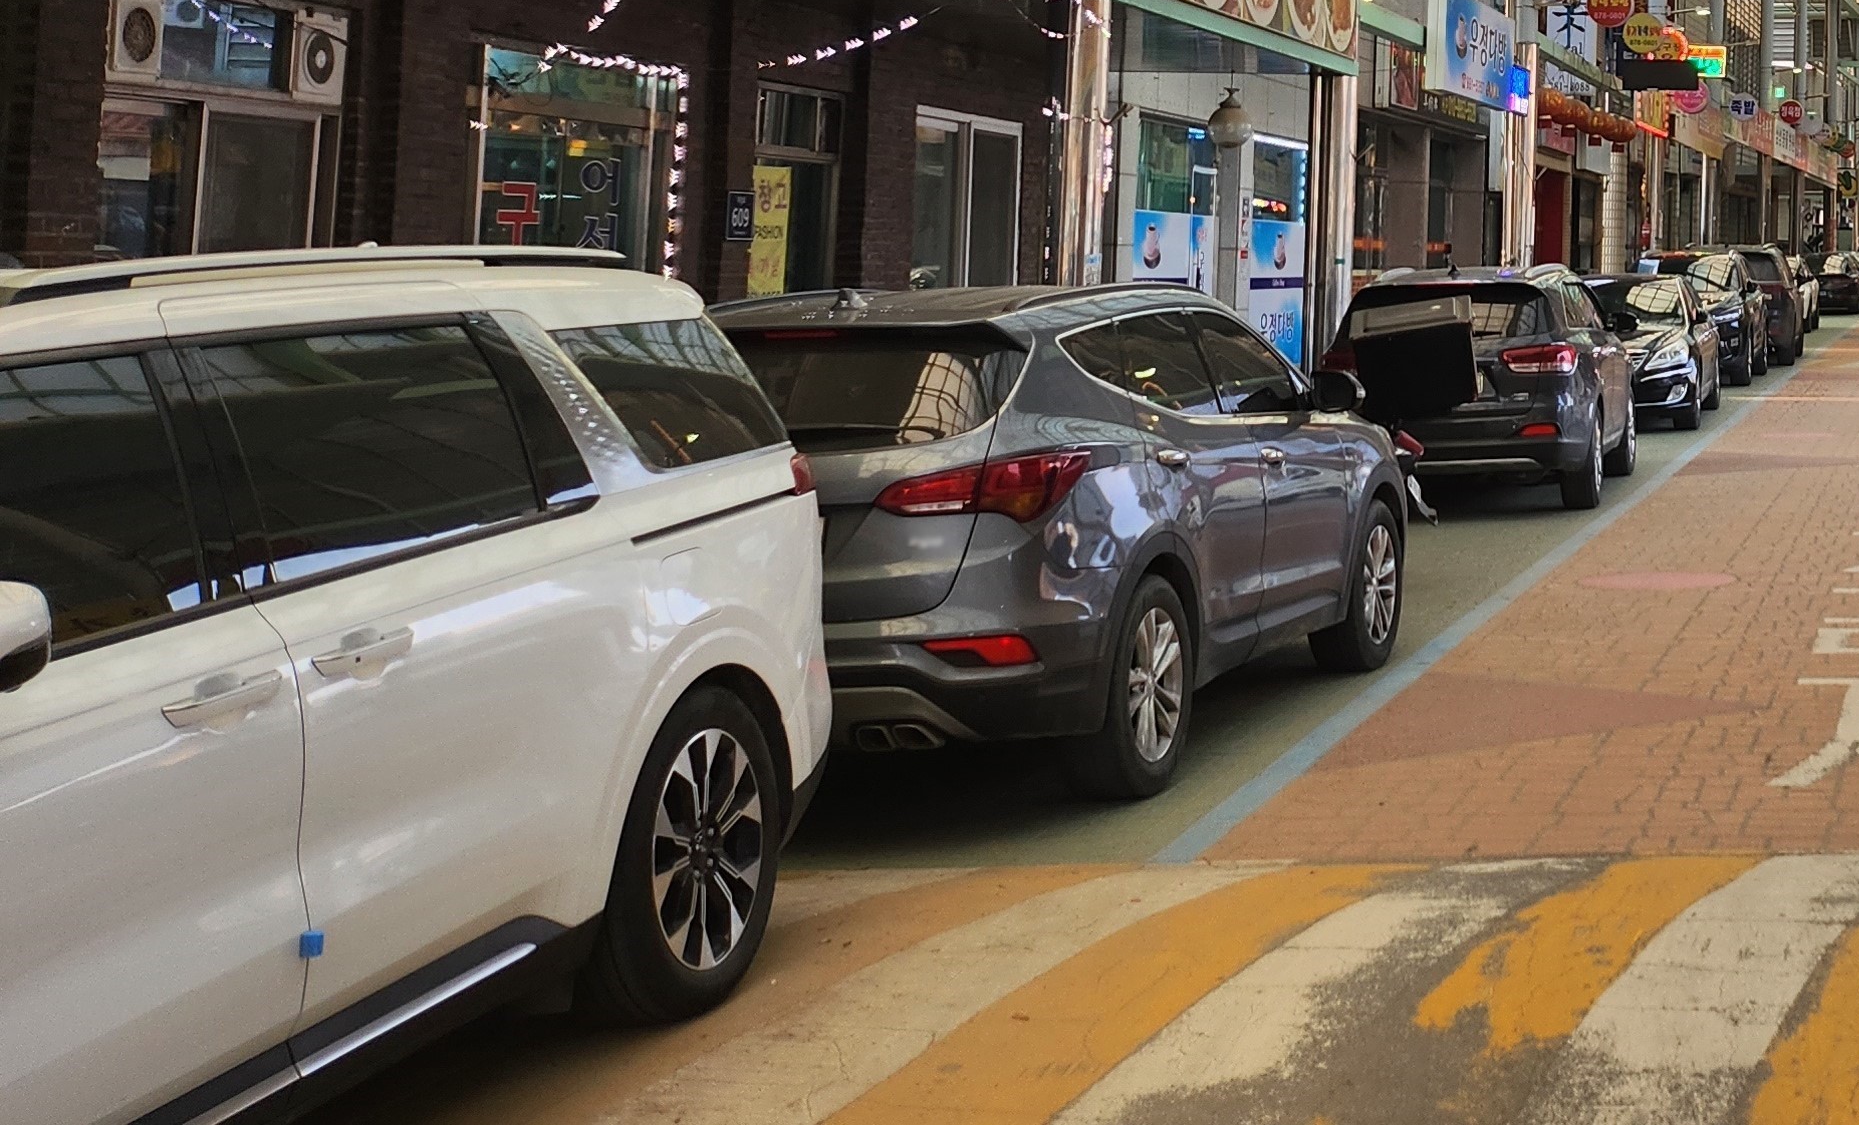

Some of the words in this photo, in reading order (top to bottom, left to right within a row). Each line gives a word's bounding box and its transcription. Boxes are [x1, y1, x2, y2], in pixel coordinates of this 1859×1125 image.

[1470, 16, 1508, 76] 우정다방
[1731, 99, 1756, 116] 족발
[731, 208, 750, 228] 609
[1260, 311, 1294, 343] 우정다방
